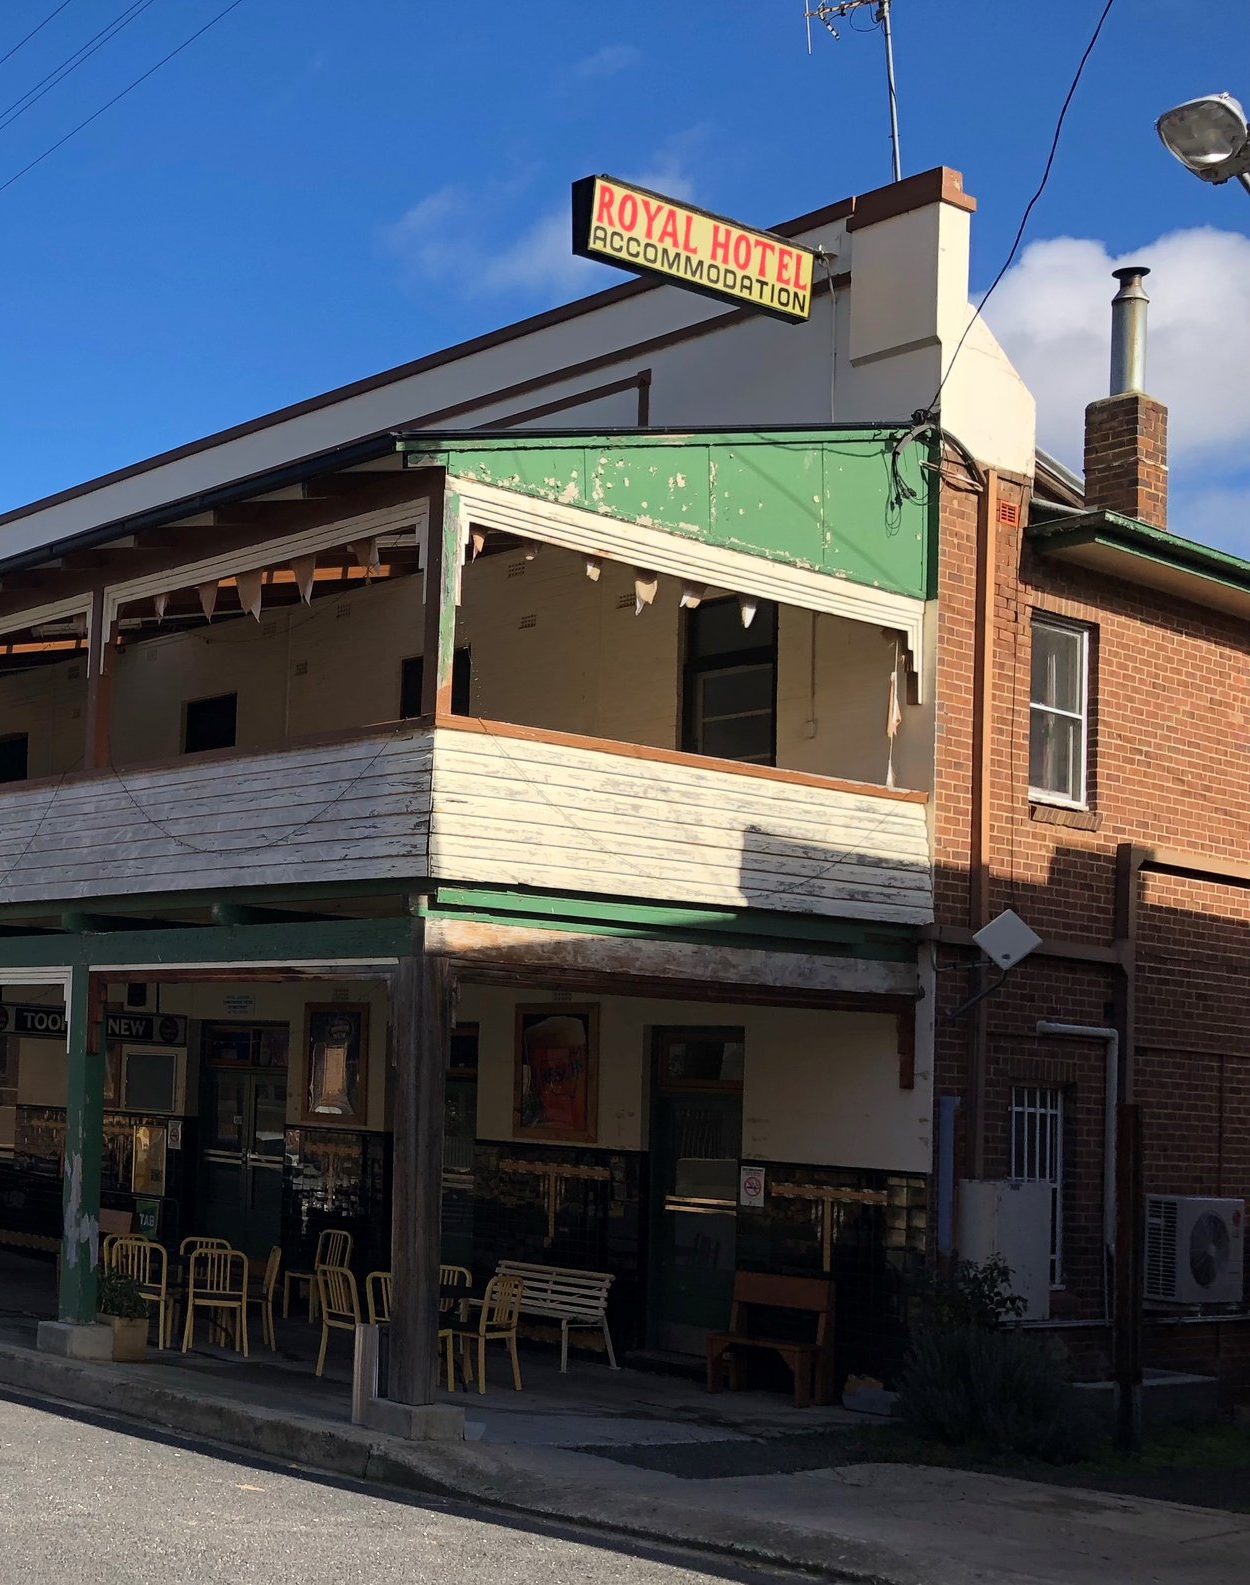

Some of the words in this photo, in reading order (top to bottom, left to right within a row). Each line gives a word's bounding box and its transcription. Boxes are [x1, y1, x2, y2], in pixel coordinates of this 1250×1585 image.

[596, 185, 698, 255] ROYAL
[710, 222, 807, 291] HOTEL
[592, 225, 806, 314] ACCOMMODATION
[108, 1016, 146, 1036] NEW
[139, 1213, 155, 1227] TAB
